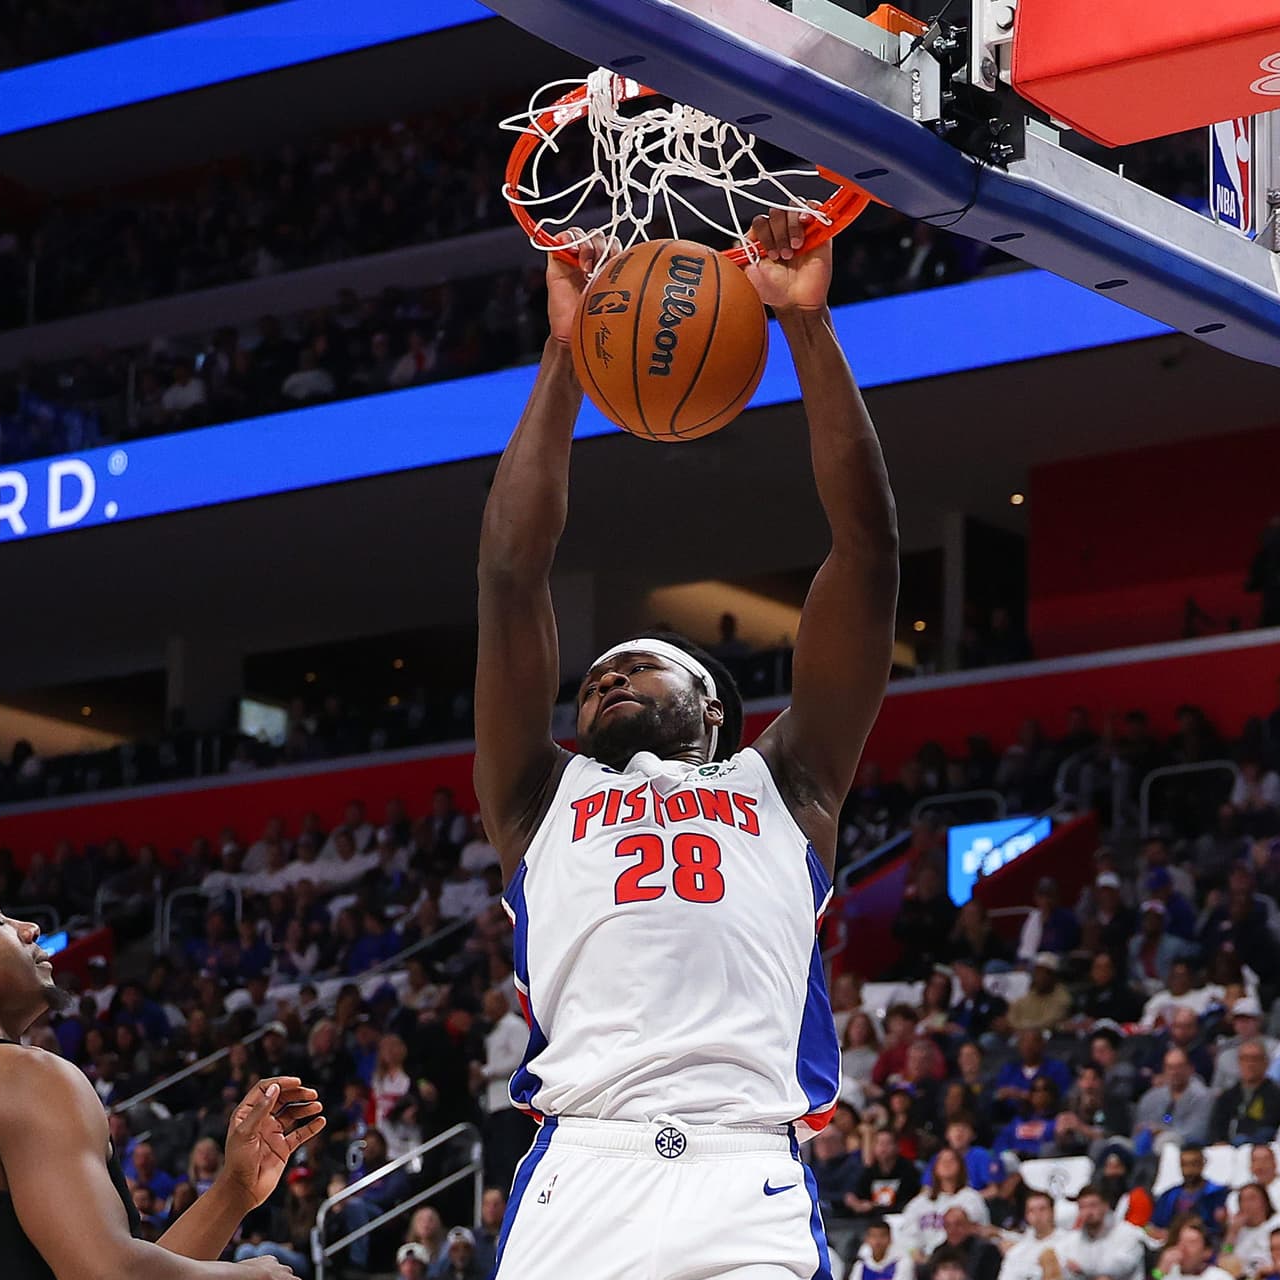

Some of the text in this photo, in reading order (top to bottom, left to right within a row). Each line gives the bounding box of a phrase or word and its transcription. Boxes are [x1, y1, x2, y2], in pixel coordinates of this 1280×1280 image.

[1216, 183, 1237, 219] NBA
[648, 254, 706, 377] Wilson
[571, 780, 760, 843] PISTONS
[614, 833, 725, 905] 28
